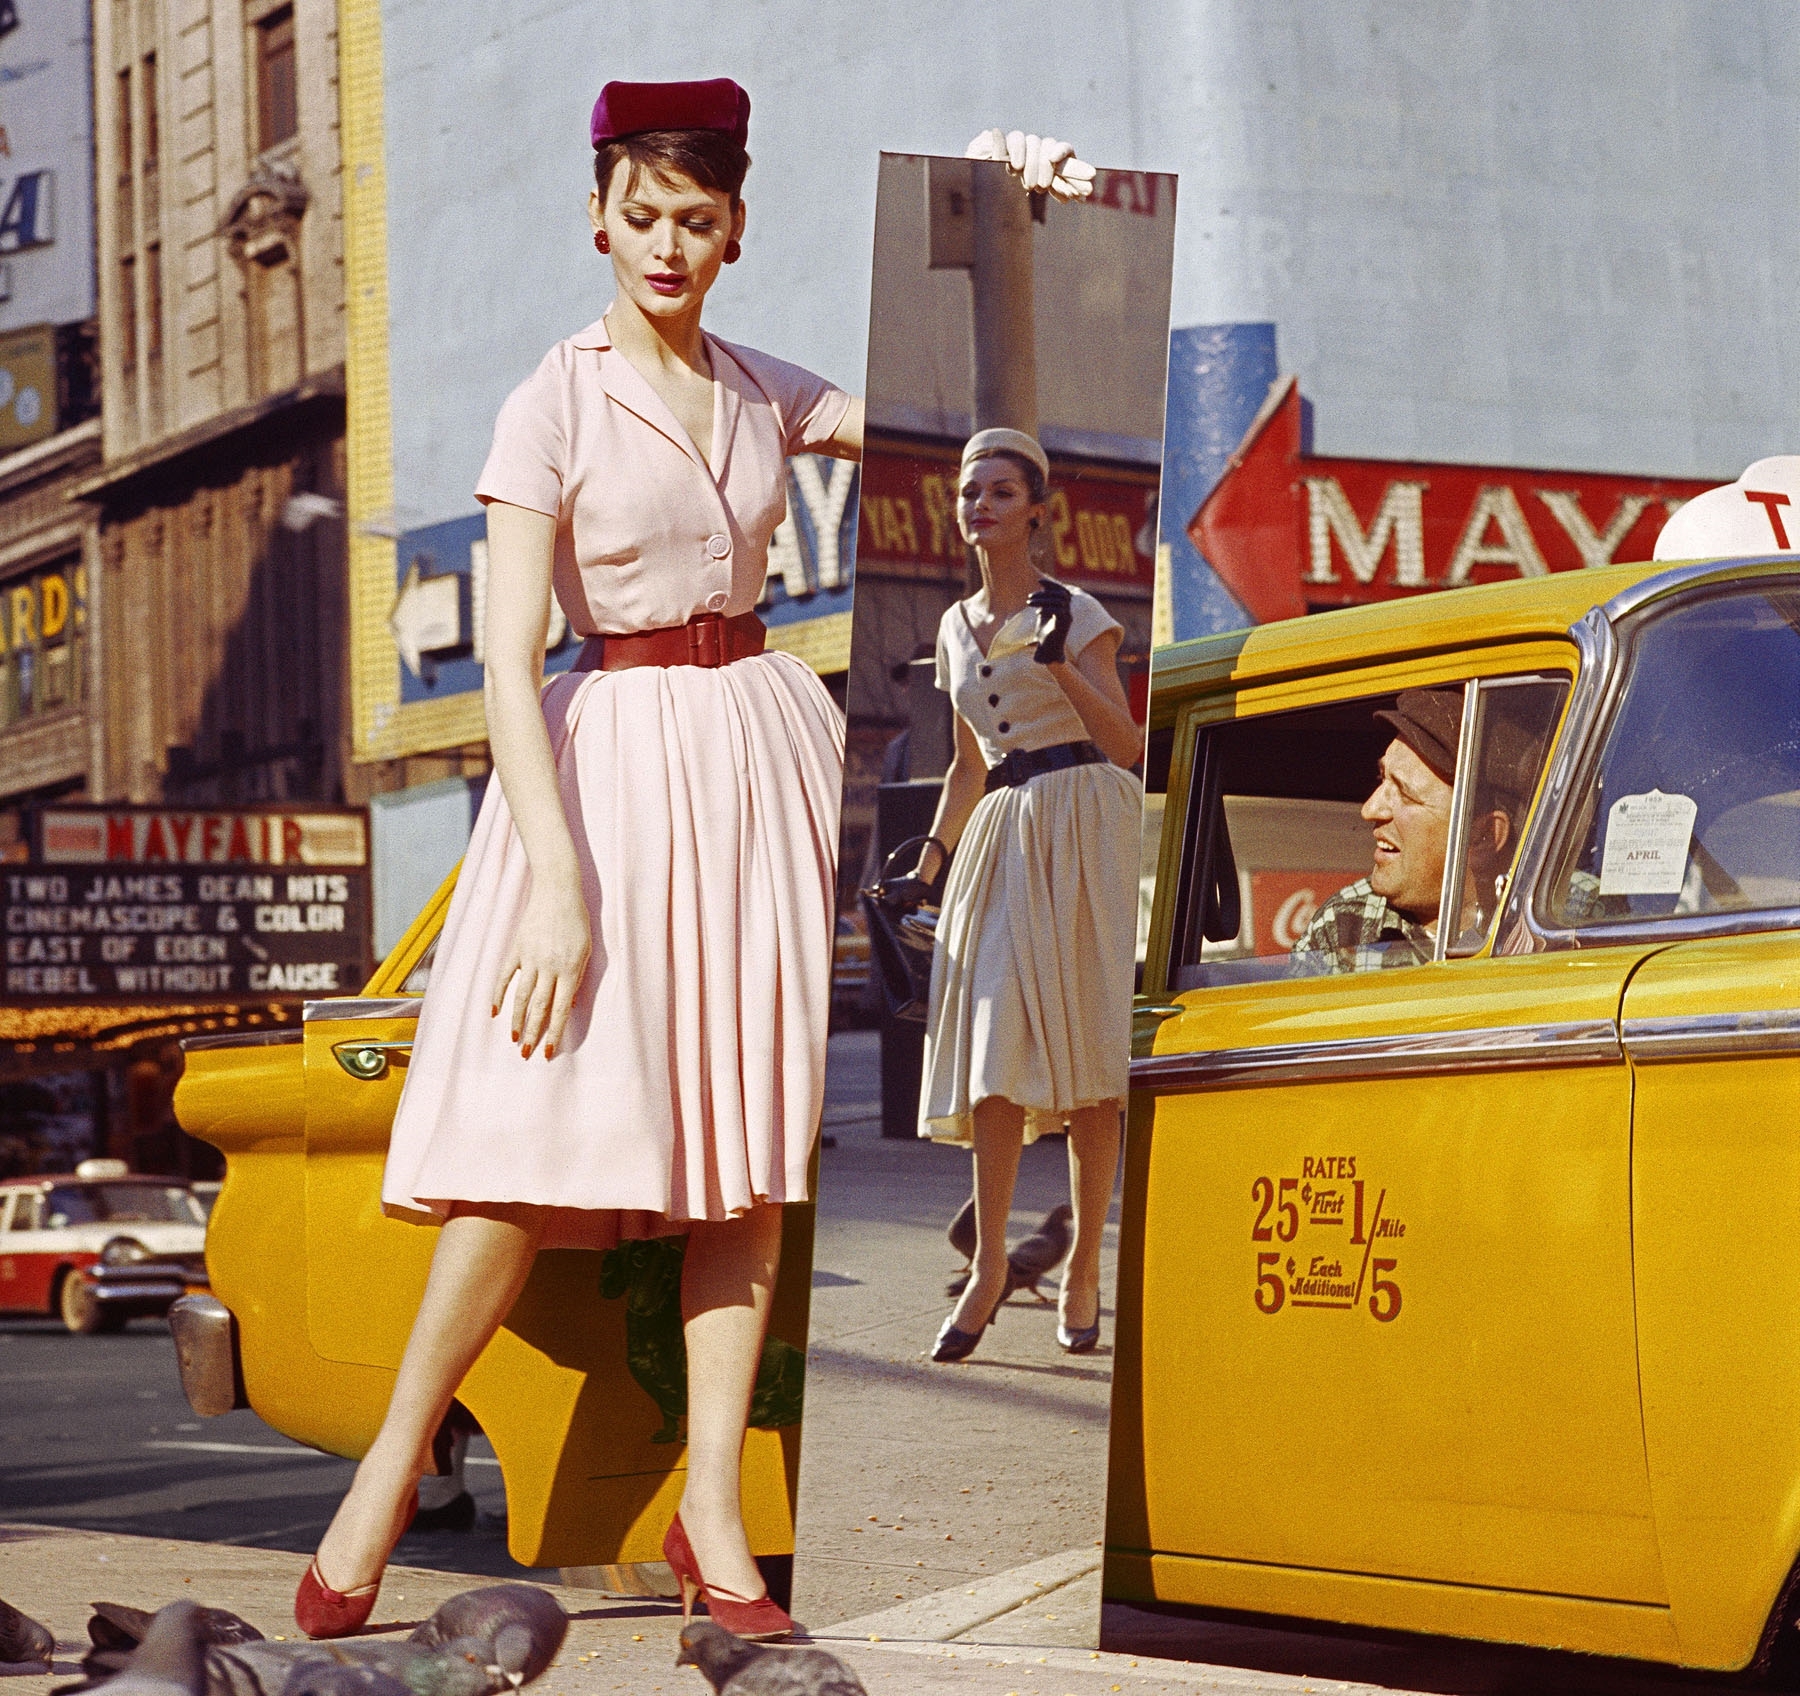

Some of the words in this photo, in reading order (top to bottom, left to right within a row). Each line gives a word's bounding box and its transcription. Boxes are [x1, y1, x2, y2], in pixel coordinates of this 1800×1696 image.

[1302, 478, 1690, 588] MAY
[105, 815, 302, 862] MAYFAIR
[1626, 850, 1661, 861] APRIL
[8, 875, 69, 901] TWO
[84, 875, 183, 902] JAMES
[198, 875, 273, 902] DEAN
[286, 875, 349, 902] HITS
[6, 904, 200, 932] CINEMASCOPE
[216, 904, 239, 932] &
[255, 904, 345, 932] COLOR
[7, 935, 85, 963] EAST
[101, 934, 138, 962] OF
[154, 934, 227, 962] EDEN
[7, 966, 98, 993] REBEL
[115, 964, 232, 993] WITHOUT
[249, 962, 340, 991] CAUSE
[1302, 1156, 1356, 1179] RATES
[1310, 1190, 1344, 1214] First
[1376, 1218, 1407, 1238] Mile
[1308, 1256, 1343, 1278] Each
[1289, 1277, 1355, 1298] Additional
